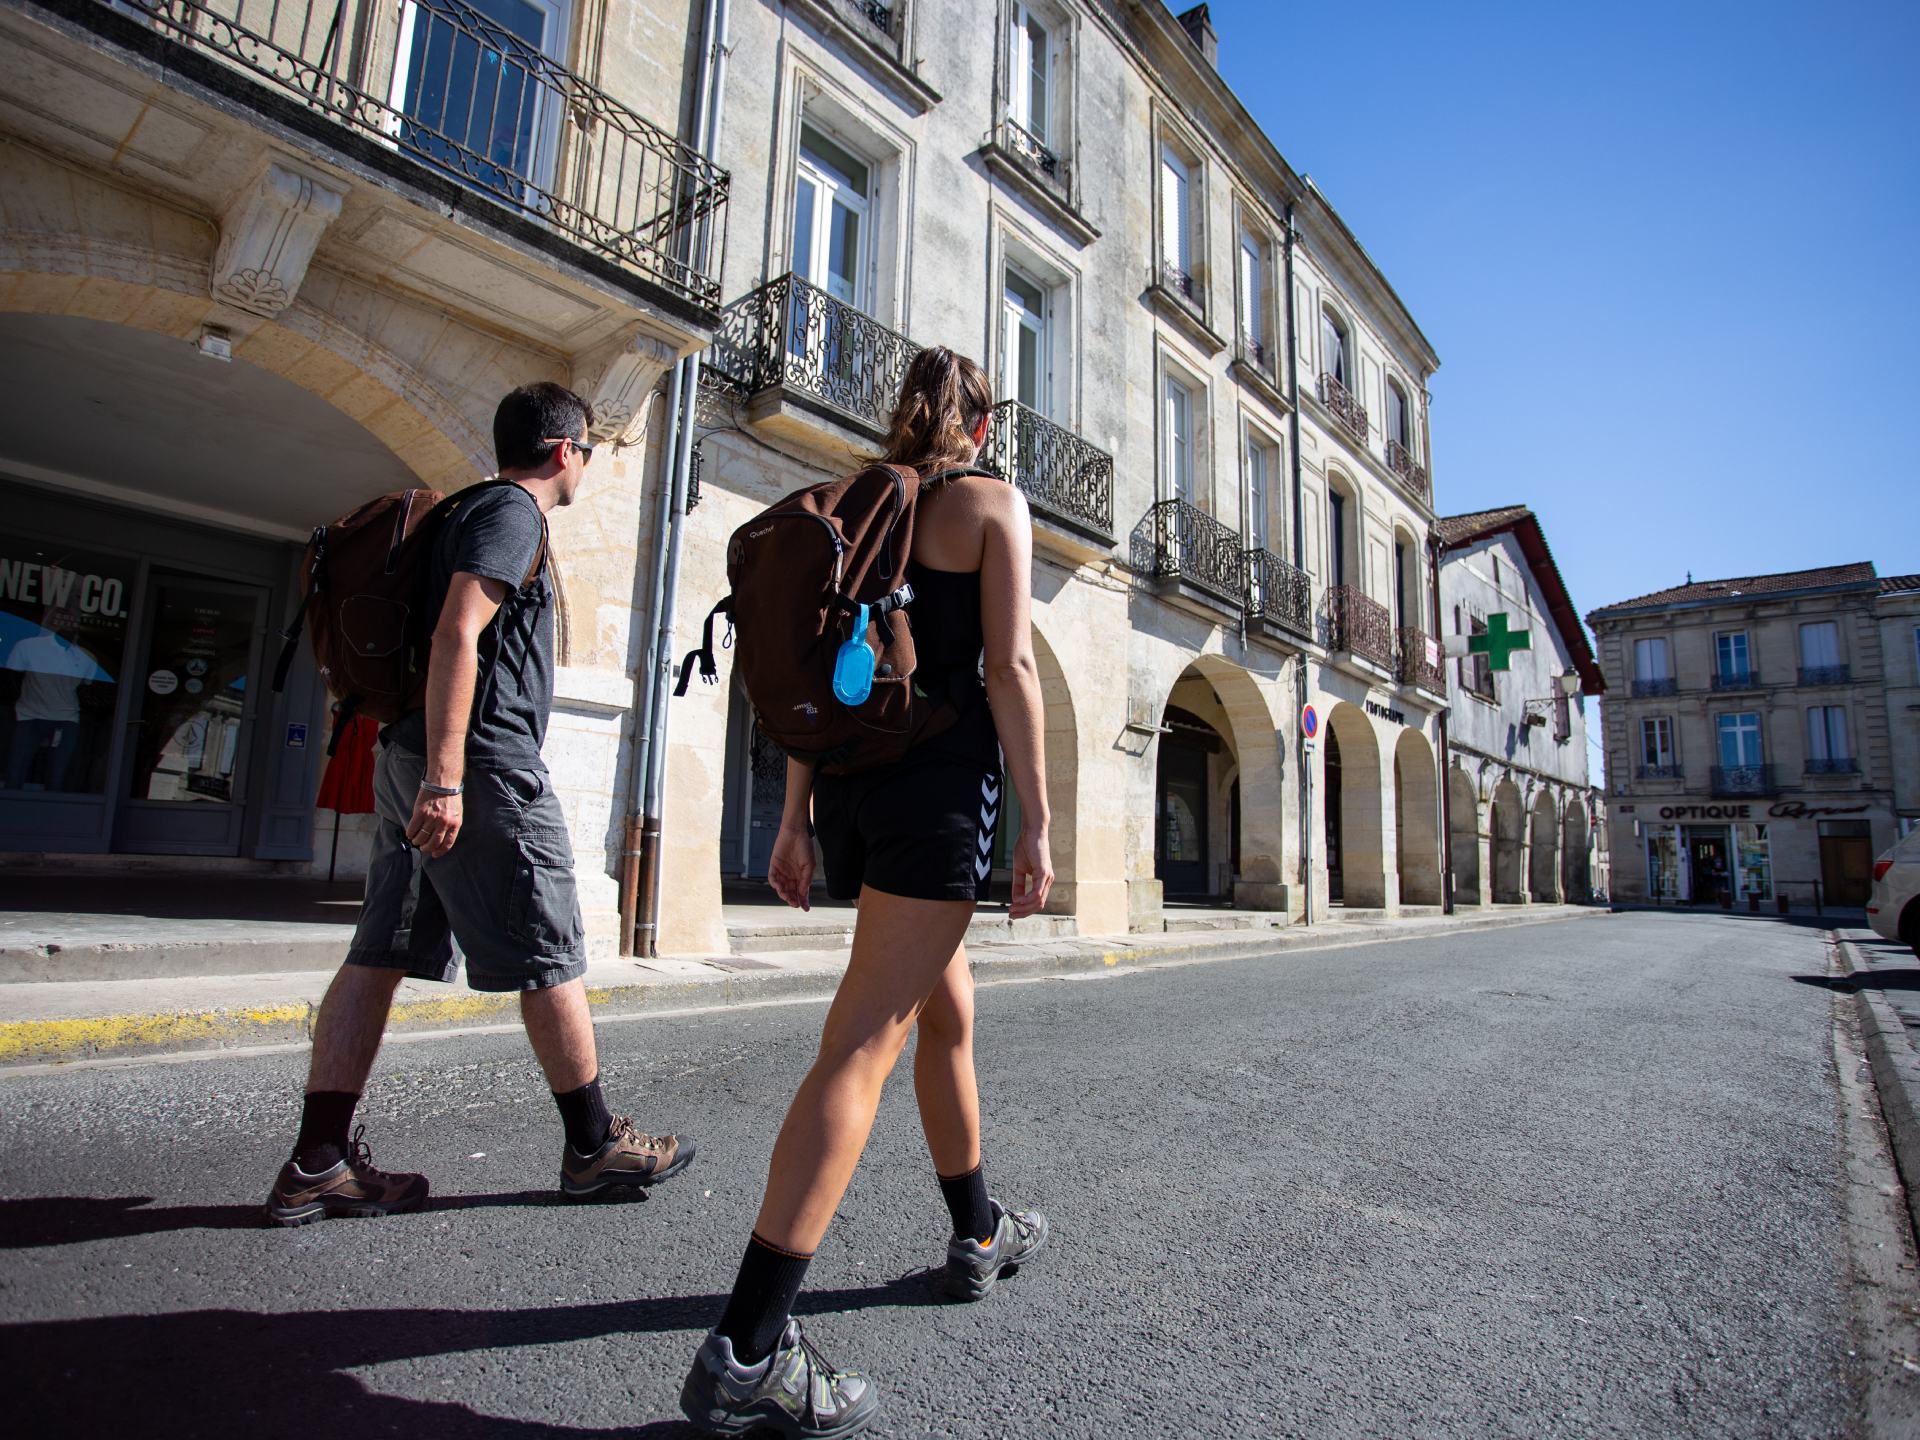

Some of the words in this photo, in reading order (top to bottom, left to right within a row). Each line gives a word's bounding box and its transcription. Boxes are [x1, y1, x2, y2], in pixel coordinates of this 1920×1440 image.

[0, 558, 77, 608] NEW
[80, 574, 128, 618] CO.
[1659, 804, 1750, 820] OPTIQUE
